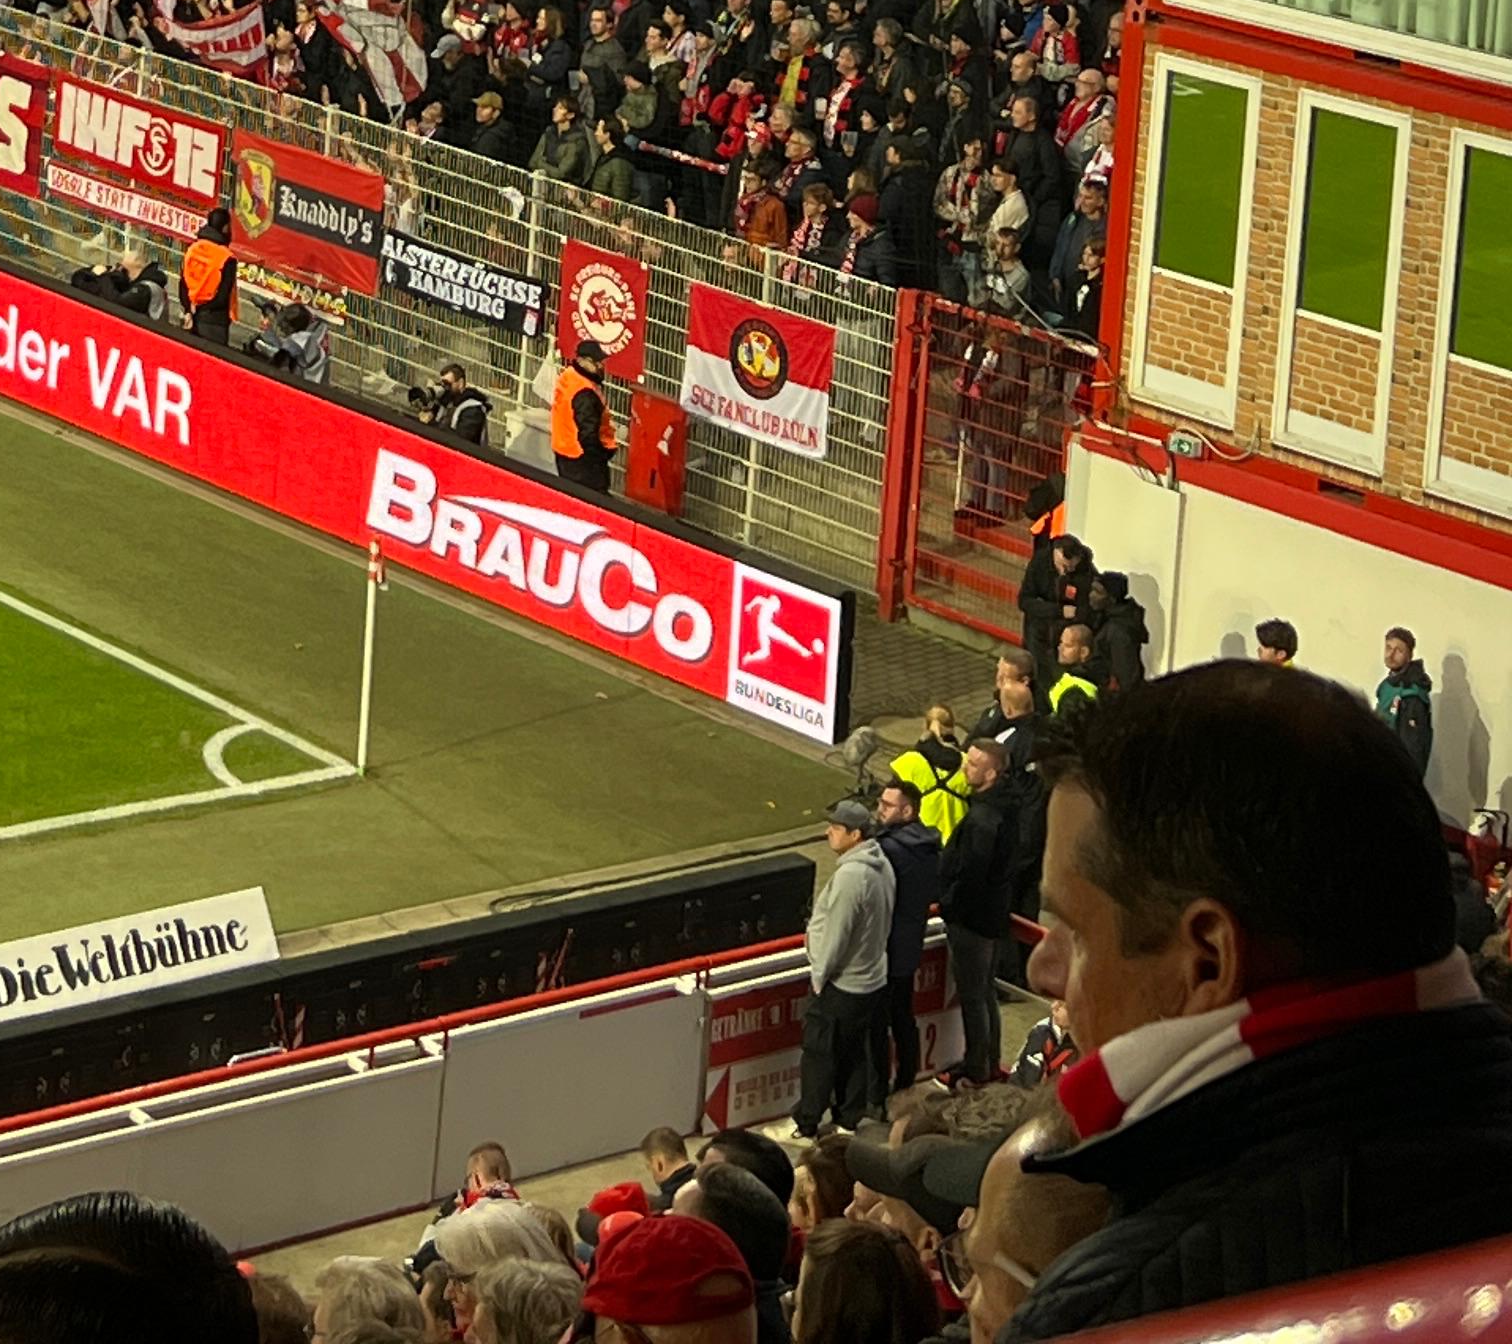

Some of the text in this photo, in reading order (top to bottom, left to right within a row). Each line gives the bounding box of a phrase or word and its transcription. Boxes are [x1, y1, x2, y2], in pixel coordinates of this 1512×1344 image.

[381, 234, 543, 309] ALSTERFÜCHSE
[407, 269, 506, 321] HAMBURG
[85, 335, 194, 447] VAR
[717, 395, 781, 436] FANCLUB
[734, 678, 826, 731] BUNDESLIGA
